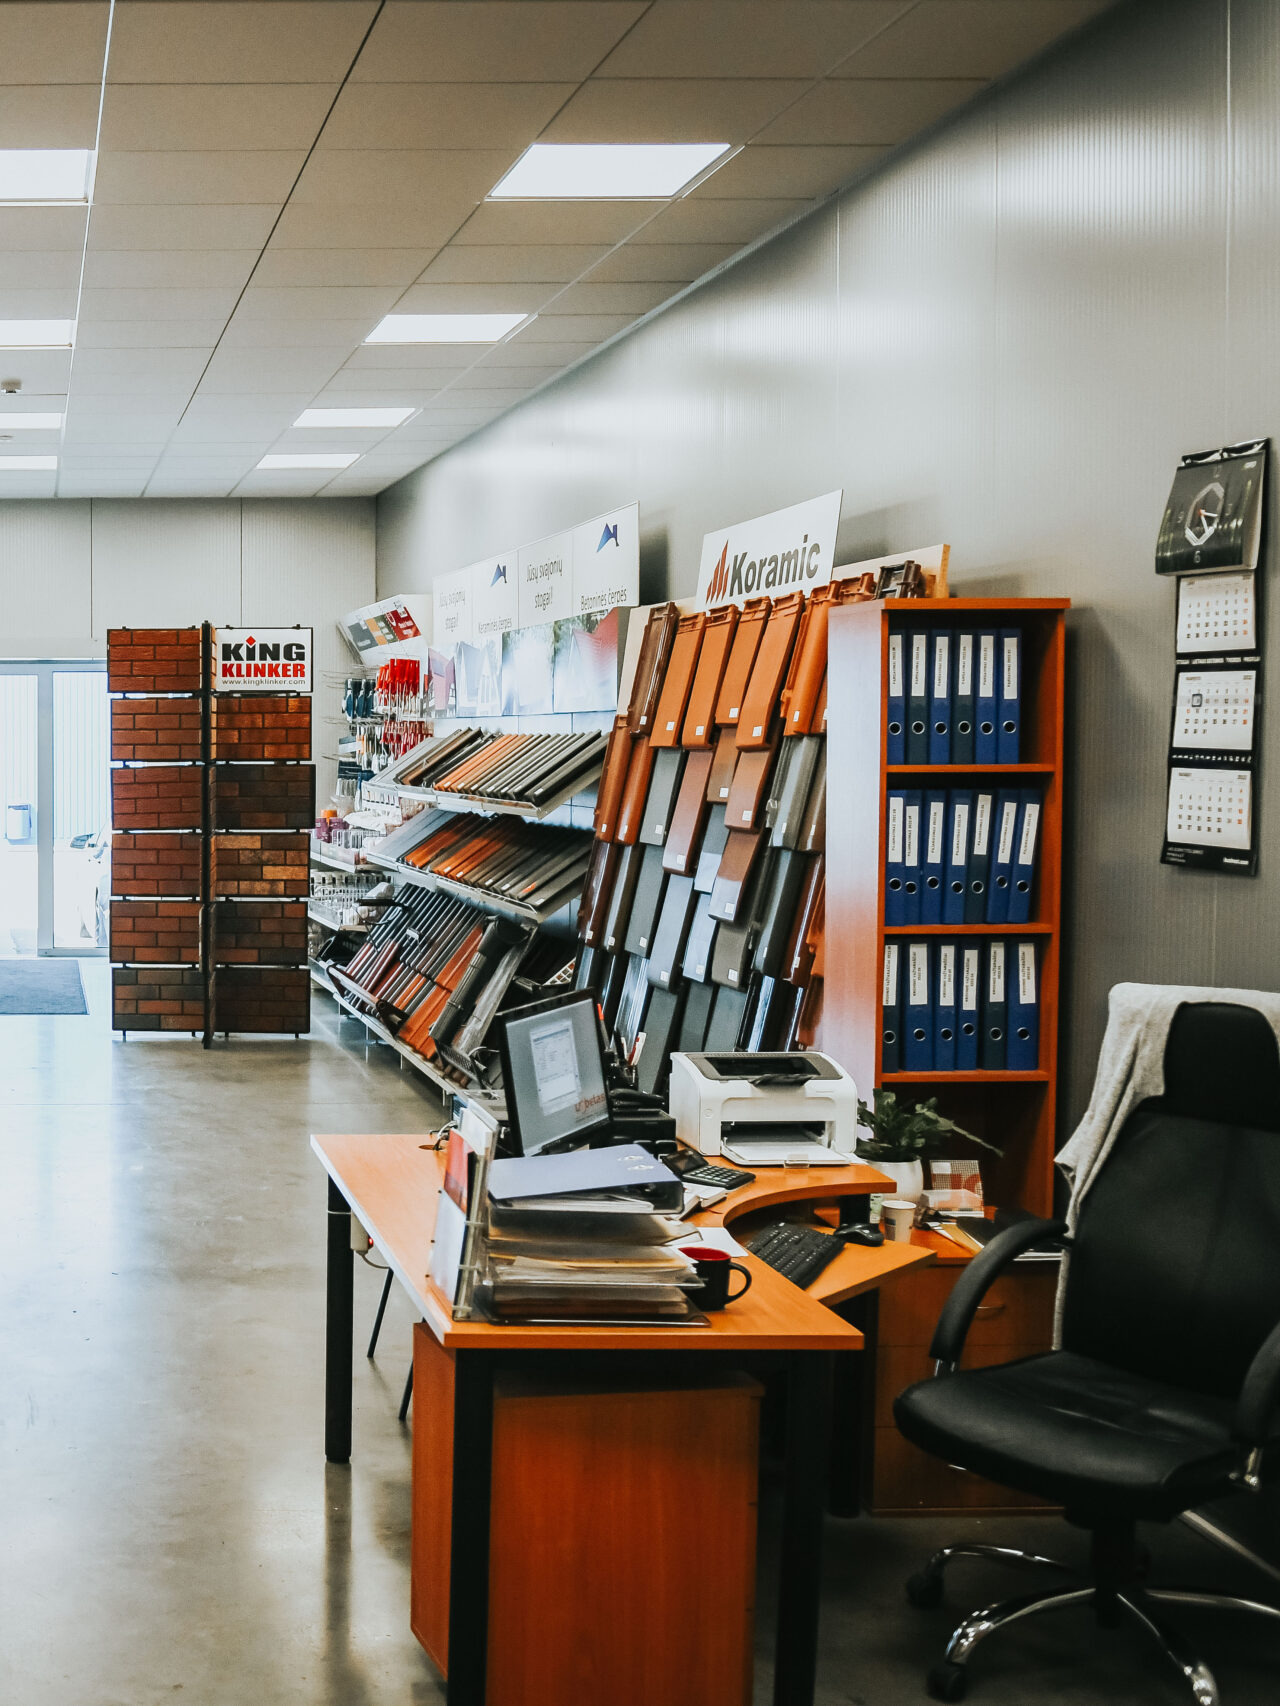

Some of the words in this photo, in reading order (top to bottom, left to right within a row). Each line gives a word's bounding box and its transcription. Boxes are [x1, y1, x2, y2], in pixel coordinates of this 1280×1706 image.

[729, 534, 820, 597] Koramic
[221, 663, 306, 678] KLINKER
[222, 679, 306, 687] www.kingklinker.com
